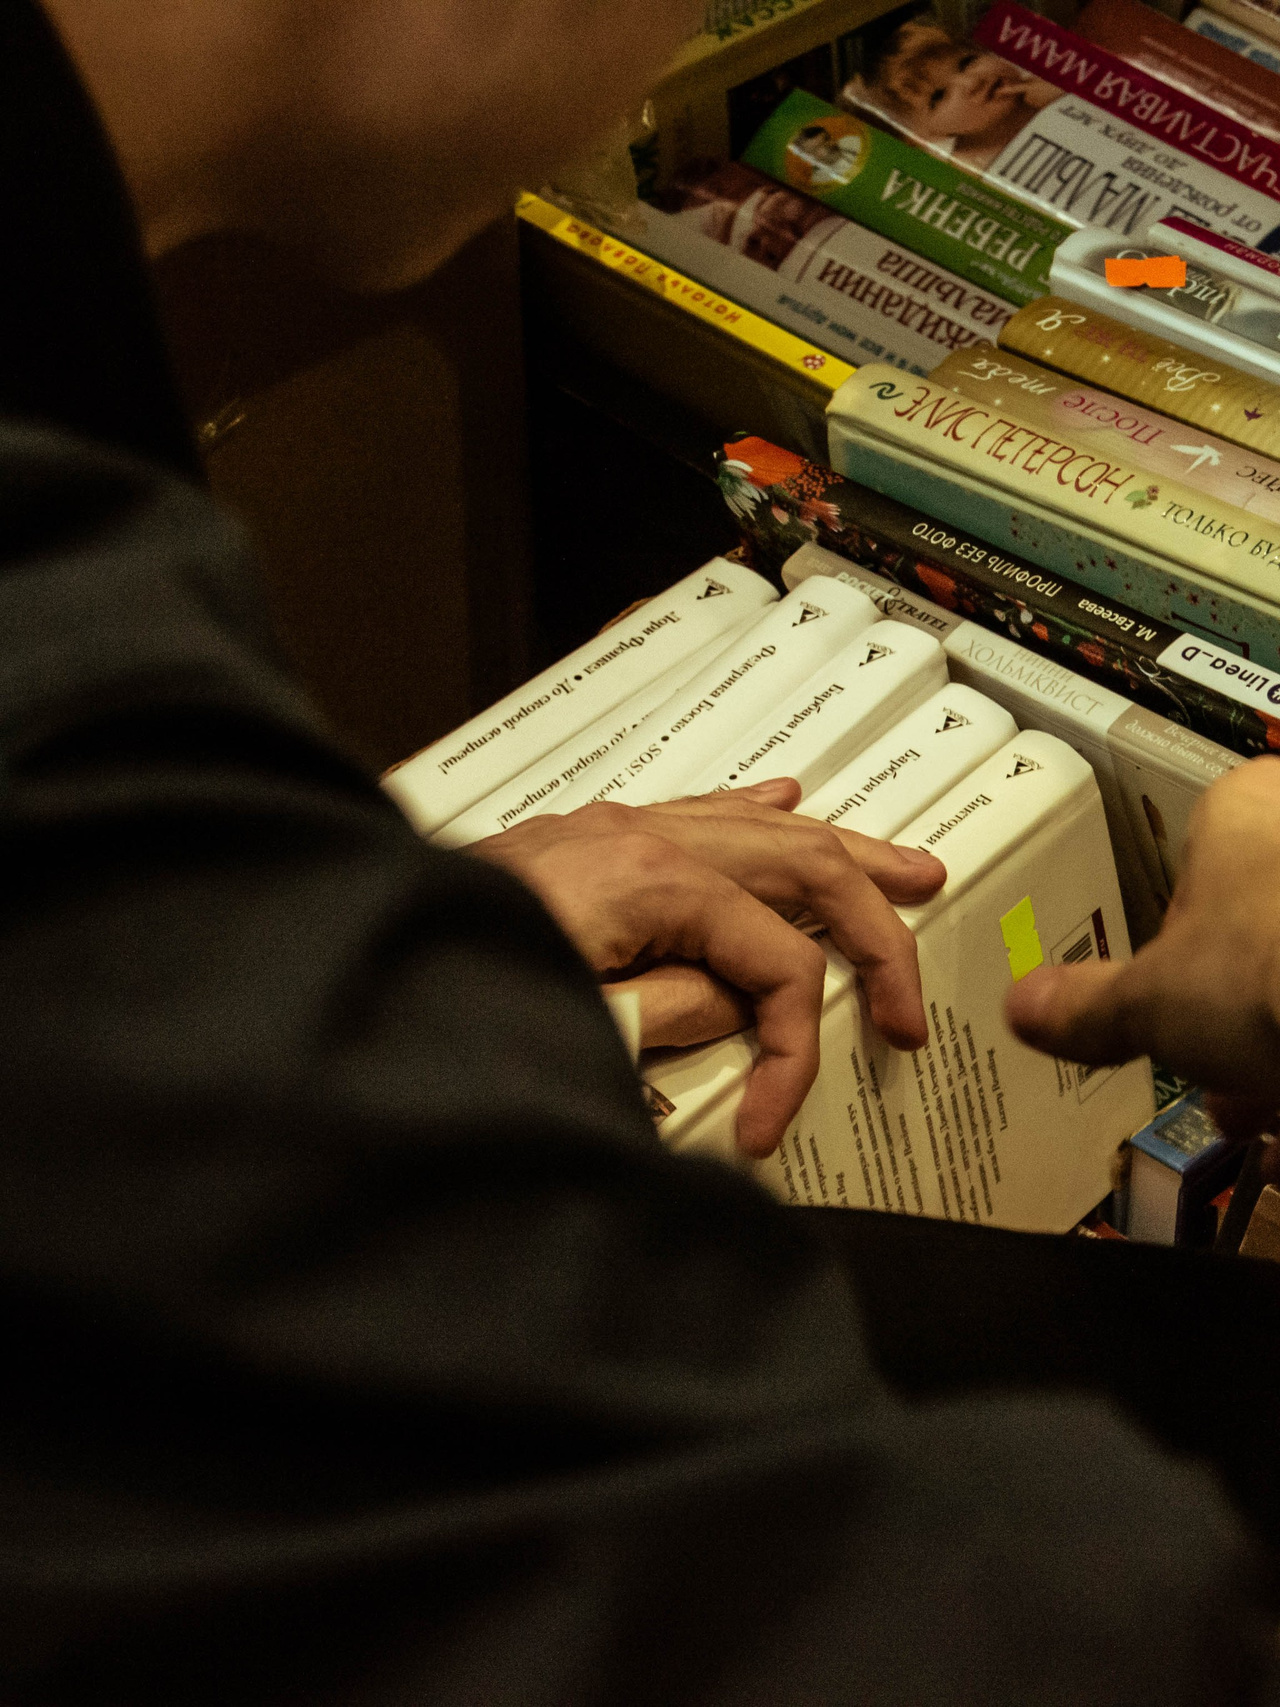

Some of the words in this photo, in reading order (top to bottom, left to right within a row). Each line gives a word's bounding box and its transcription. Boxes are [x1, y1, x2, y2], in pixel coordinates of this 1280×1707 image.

[998, 14, 1099, 87] МАМА
[999, 132, 1163, 238] МАЛЫШ
[882, 167, 1041, 275] РЕБЕНКА
[957, 354, 1058, 399] тебя
[894, 384, 980, 450] ЭЛИС
[970, 416, 1140, 507] ПЕТЕРСОН
[1061, 393, 1166, 449] После
[910, 520, 957, 556] ФОТО
[1161, 500, 1252, 551] ТОЛЬКО
[951, 537, 985, 567] БЕЗ
[981, 551, 1064, 600] ПРОФИЛЬ
[1077, 596, 1134, 633] Евсеева
[709, 643, 777, 700] Федерика
[1181, 643, 1270, 692] Linea_D
[500, 690, 553, 732] скорой
[669, 697, 715, 737] Боско
[789, 682, 845, 735] Барбара
[438, 725, 502, 777] встречи!
[561, 742, 611, 786] скорой
[625, 742, 662, 780] SOS!
[736, 727, 793, 776] Цитвер
[866, 747, 922, 802] Барбара
[498, 778, 562, 831] встречи!
[823, 793, 868, 828] Цитв
[924, 792, 993, 849] Виктория
